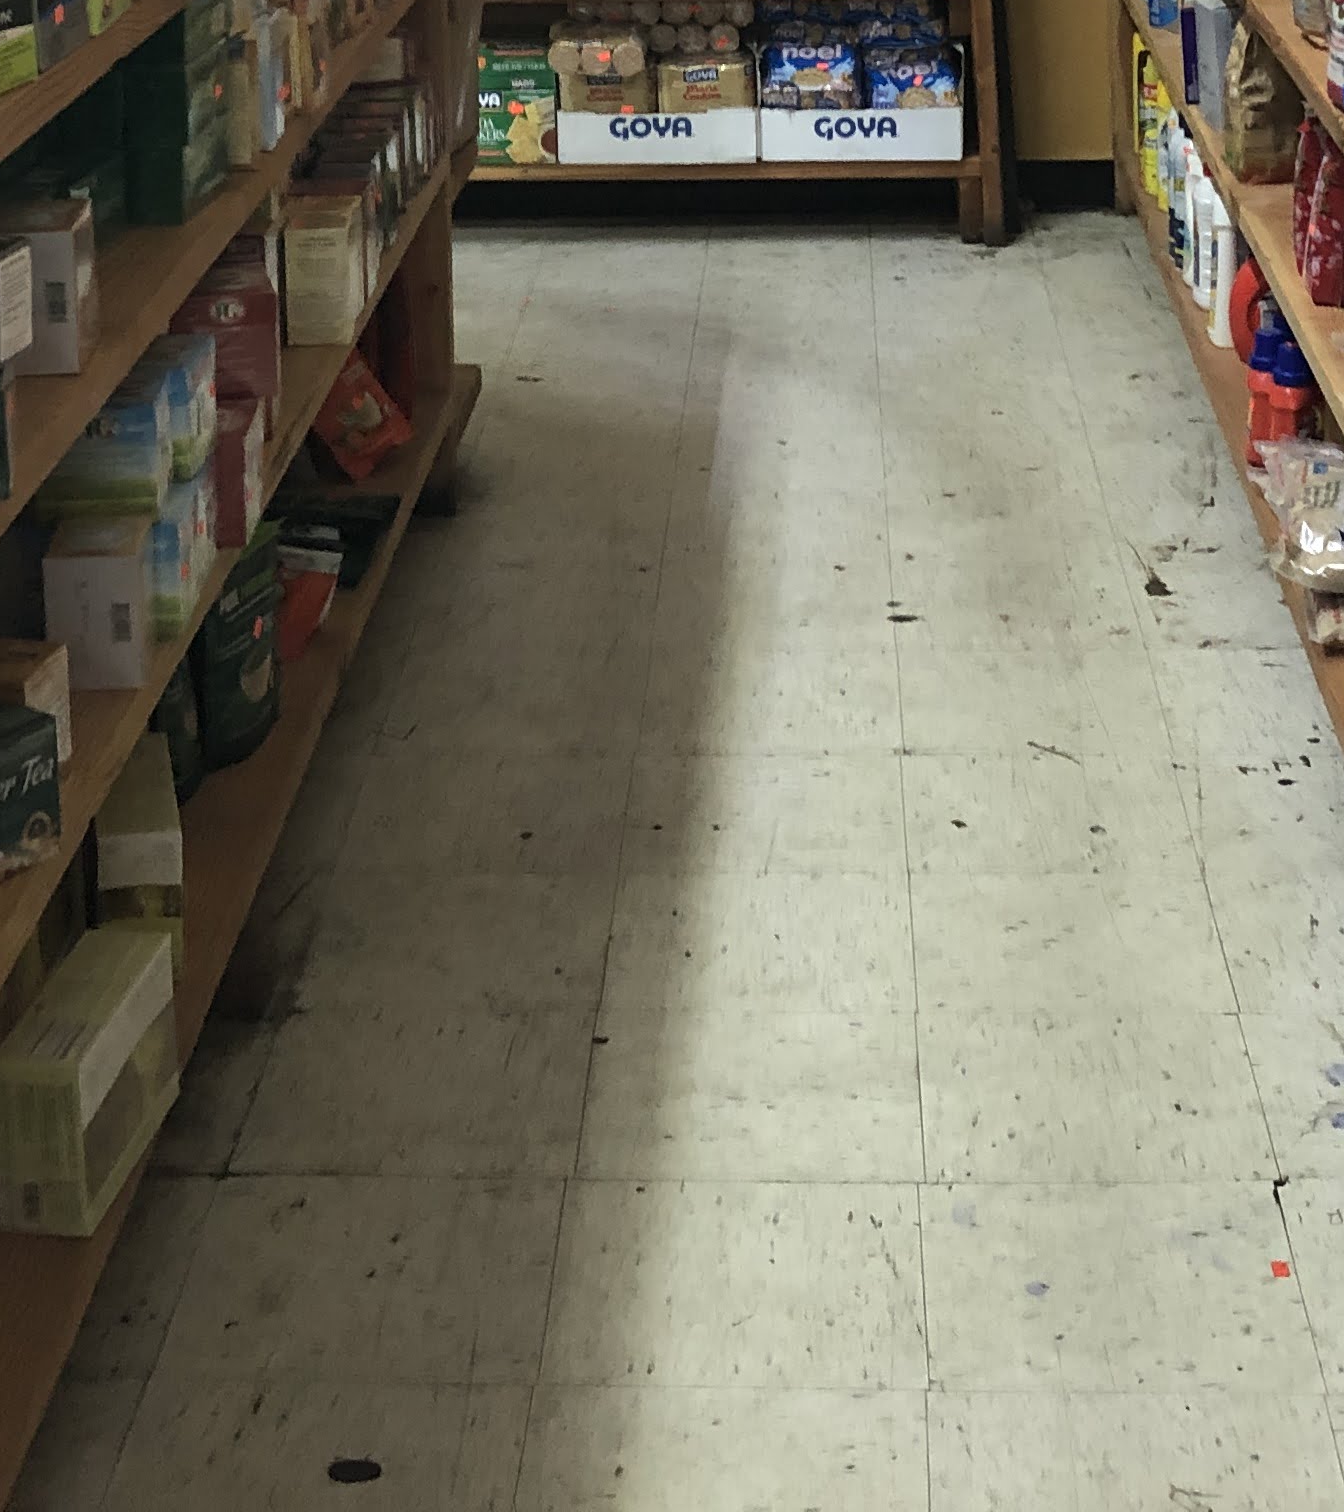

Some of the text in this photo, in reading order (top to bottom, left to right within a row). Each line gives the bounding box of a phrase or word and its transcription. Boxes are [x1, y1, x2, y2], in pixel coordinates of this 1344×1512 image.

[782, 44, 843, 60] noel
[479, 93, 501, 108] YA
[609, 117, 693, 141] GOYA
[814, 116, 897, 140] GOYA
